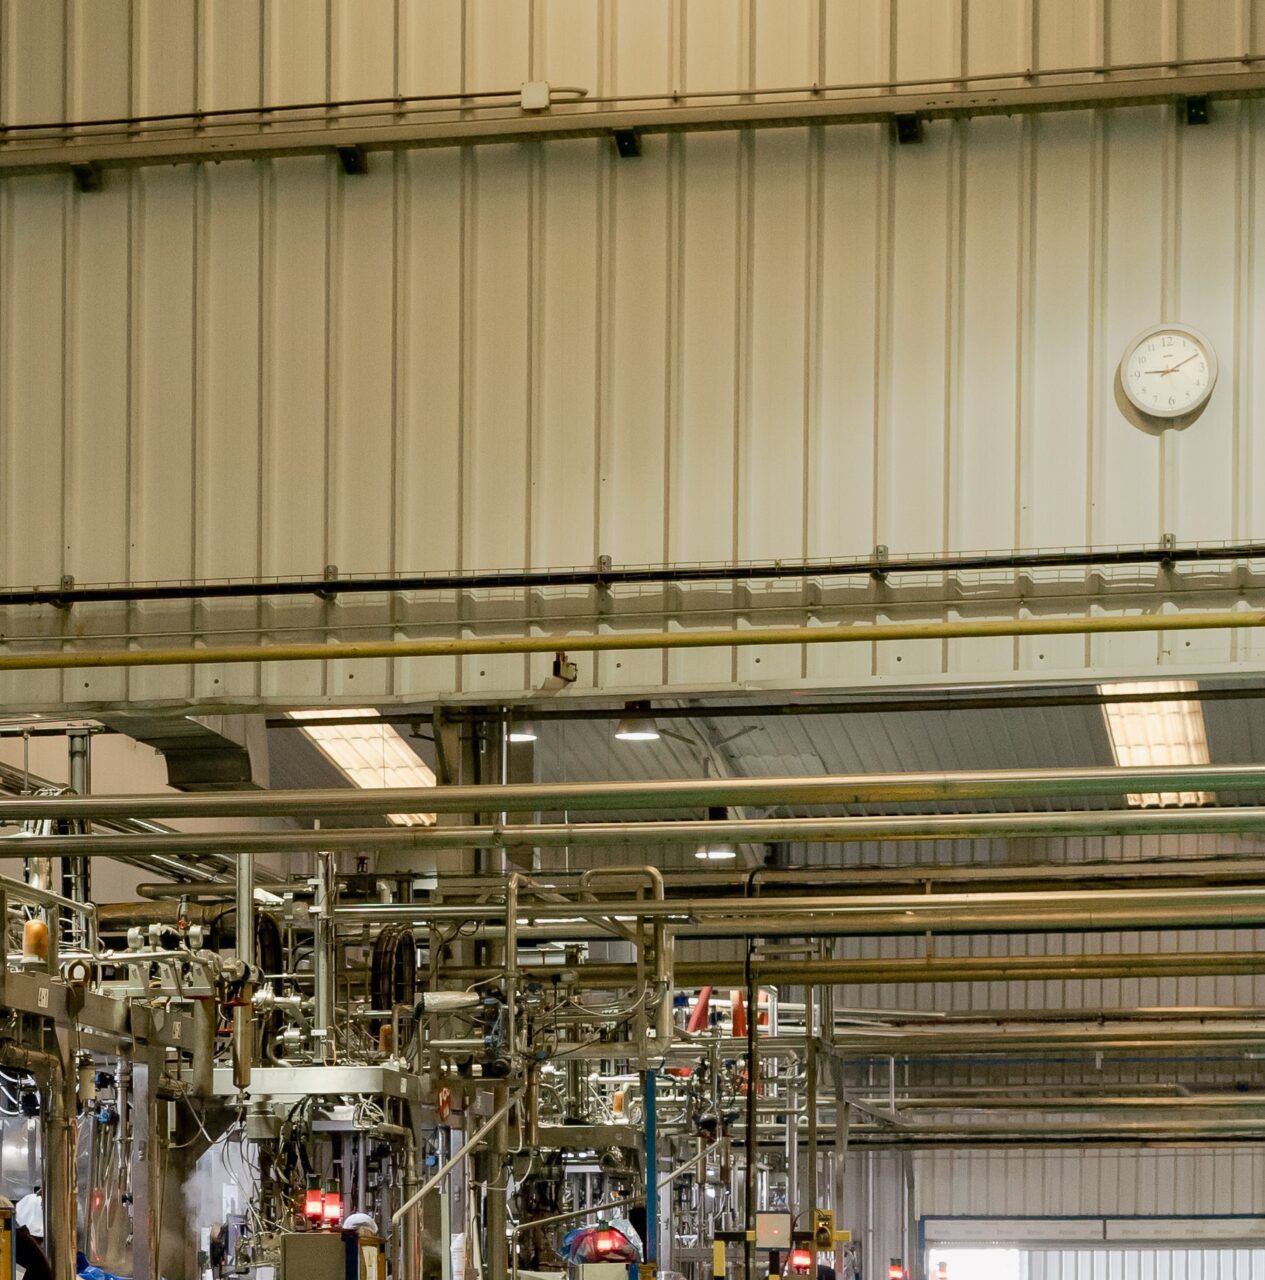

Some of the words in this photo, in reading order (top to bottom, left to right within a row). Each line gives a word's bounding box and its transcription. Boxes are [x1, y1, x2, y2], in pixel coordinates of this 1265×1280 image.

[1161, 336, 1174, 347] 12
[1147, 343, 1155, 352] 11
[1138, 356, 1147, 364] 10
[1200, 362, 1205, 372] 3
[1135, 370, 1140, 380] 9
[1168, 396, 1175, 405] 6
